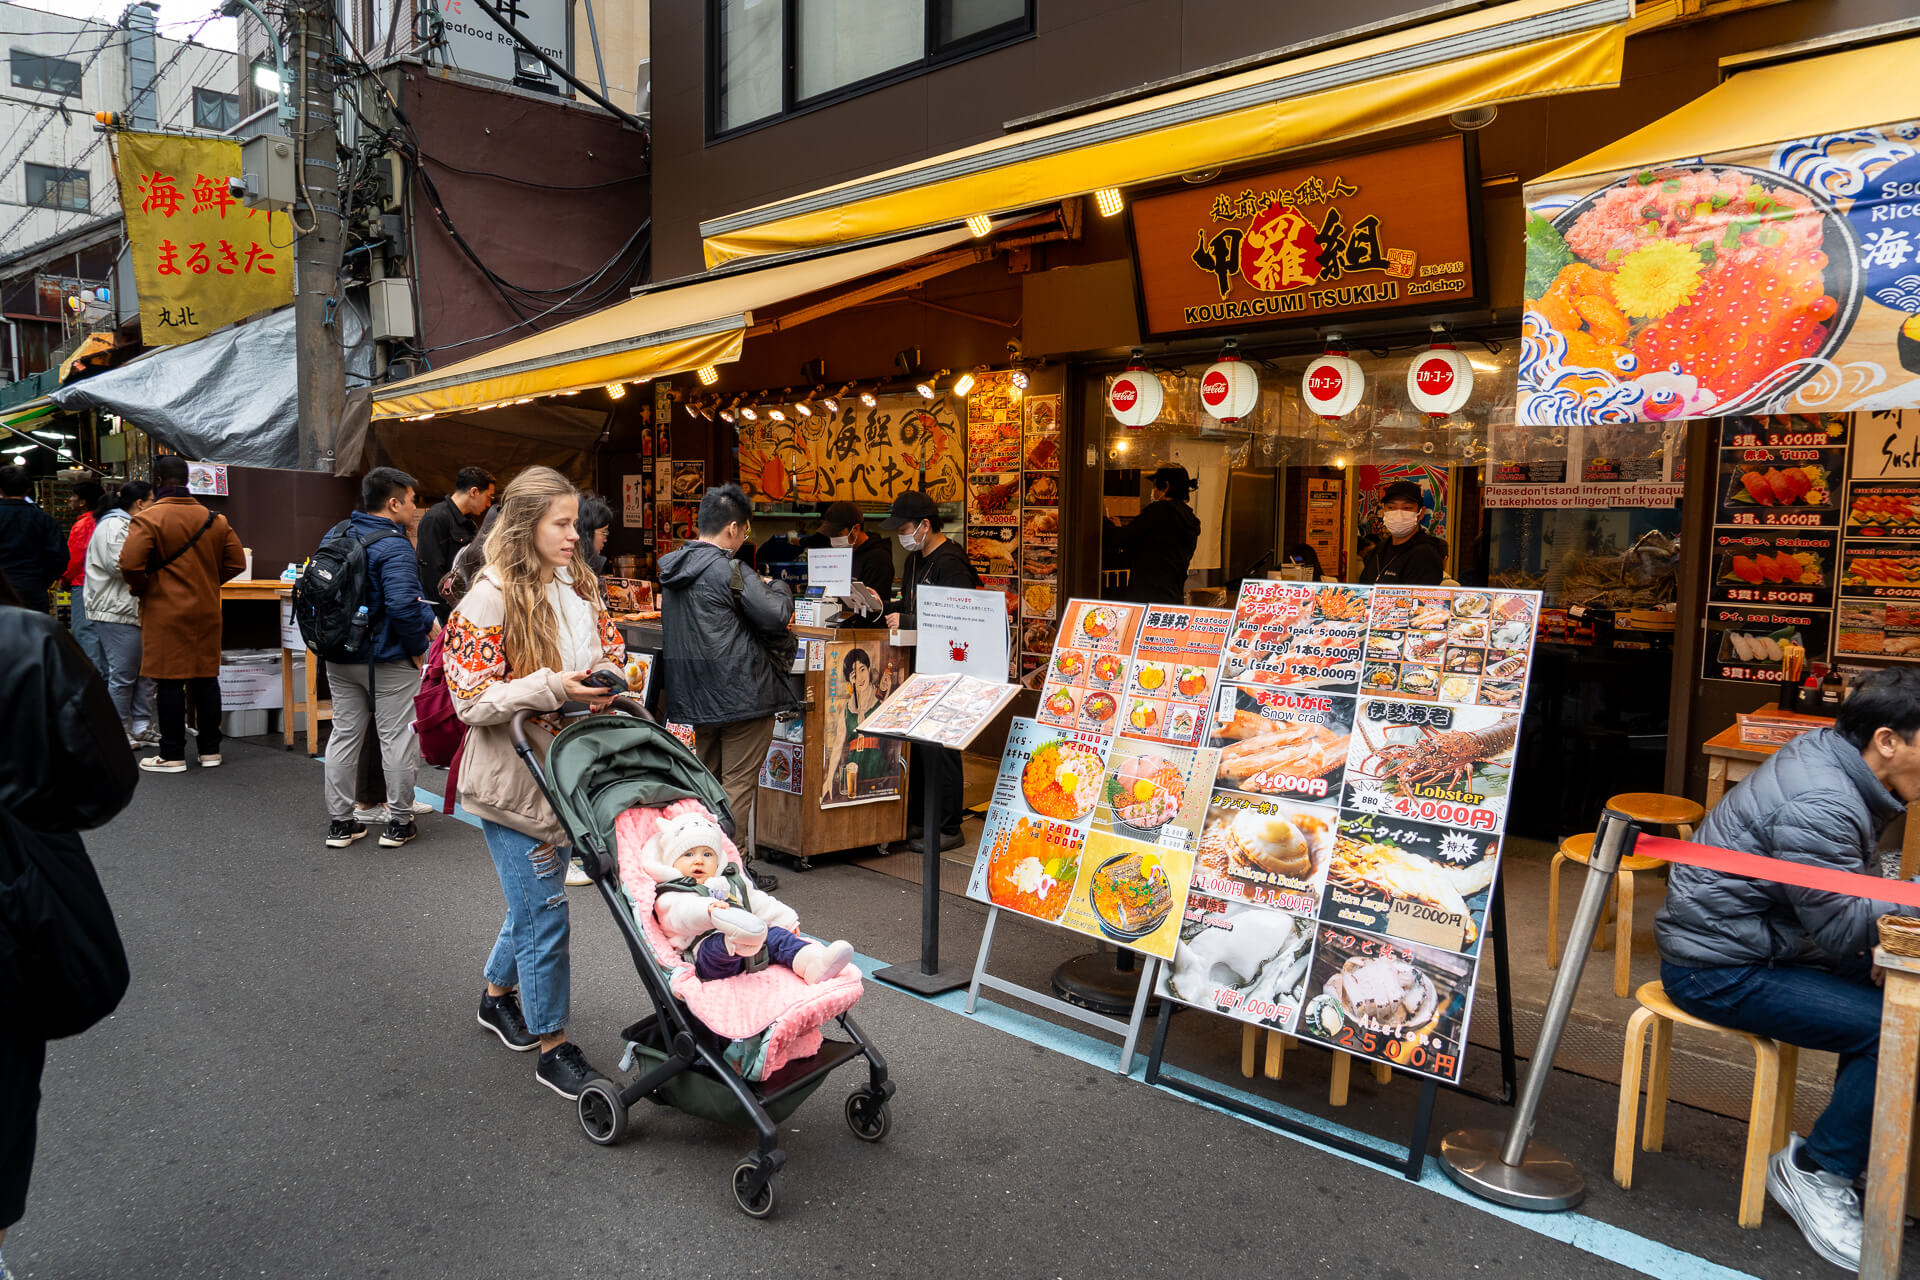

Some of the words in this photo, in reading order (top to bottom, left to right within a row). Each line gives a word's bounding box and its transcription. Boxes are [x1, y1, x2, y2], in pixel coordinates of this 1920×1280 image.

[443, 20, 493, 41] eafood
[137, 170, 271, 222] 海鮮
[1210, 176, 1358, 222] 越前かに職人
[157, 239, 276, 275] まるきた
[1192, 207, 1390, 300] 甲羅組
[1860, 227, 1920, 270] 海
[1408, 281, 1434, 295] 2nd
[1433, 278, 1464, 293] shop
[1184, 293, 1304, 323] KOURAGUMI
[1309, 280, 1399, 309] TSUKIJI
[158, 306, 199, 327] 丸北
[1308, 376, 1342, 389] コカ・コーラ
[1416, 370, 1454, 383] コカ・コーラ
[826, 407, 893, 461] 海鮮
[1781, 449, 1820, 461] Tuna
[813, 456, 948, 498] バーベキュー
[1486, 486, 1520, 496] Please
[1549, 485, 1579, 495] stand
[1624, 484, 1636, 494] of
[1486, 498, 1496, 506] to
[1561, 497, 1573, 506] or
[1611, 495, 1646, 506] Thank
[1647, 496, 1674, 507] you!
[1776, 538, 1830, 548] Salmon
[1243, 584, 1273, 598] King
[1277, 586, 1311, 599] crab
[1246, 602, 1299, 616] タラバガニ
[1747, 613, 1770, 623] sea
[1771, 614, 1812, 626] bream
[1146, 612, 1190, 629] 海鮮丼
[1194, 616, 1229, 626] seafood
[1189, 625, 1206, 633] rice
[1238, 621, 1259, 633] King
[1263, 623, 1284, 633] crab
[1288, 626, 1315, 637] 1pack
[1319, 628, 1357, 640] 5,000円
[1235, 639, 1249, 649] 4L
[1295, 643, 1361, 661] 1本6,500円
[1230, 658, 1244, 668] 5L
[1291, 664, 1358, 682] 1本8,000円
[830, 650, 839, 713] サッポロビール
[1257, 691, 1333, 712] ずわいがに
[1262, 706, 1294, 720] Snow
[1297, 712, 1325, 725] crab
[1367, 700, 1451, 727] 伊勢海老
[1255, 772, 1329, 797] 4,000円
[1414, 783, 1484, 806] Lobster
[1361, 796, 1378, 806] BBQ
[1394, 798, 1496, 831] 4,000円
[1446, 842, 1469, 854] 特大
[1277, 875, 1310, 892] Butter
[1395, 902, 1409, 916] M
[1413, 905, 1463, 928] 2000円
[1213, 989, 1292, 1024] 1個1,000円
